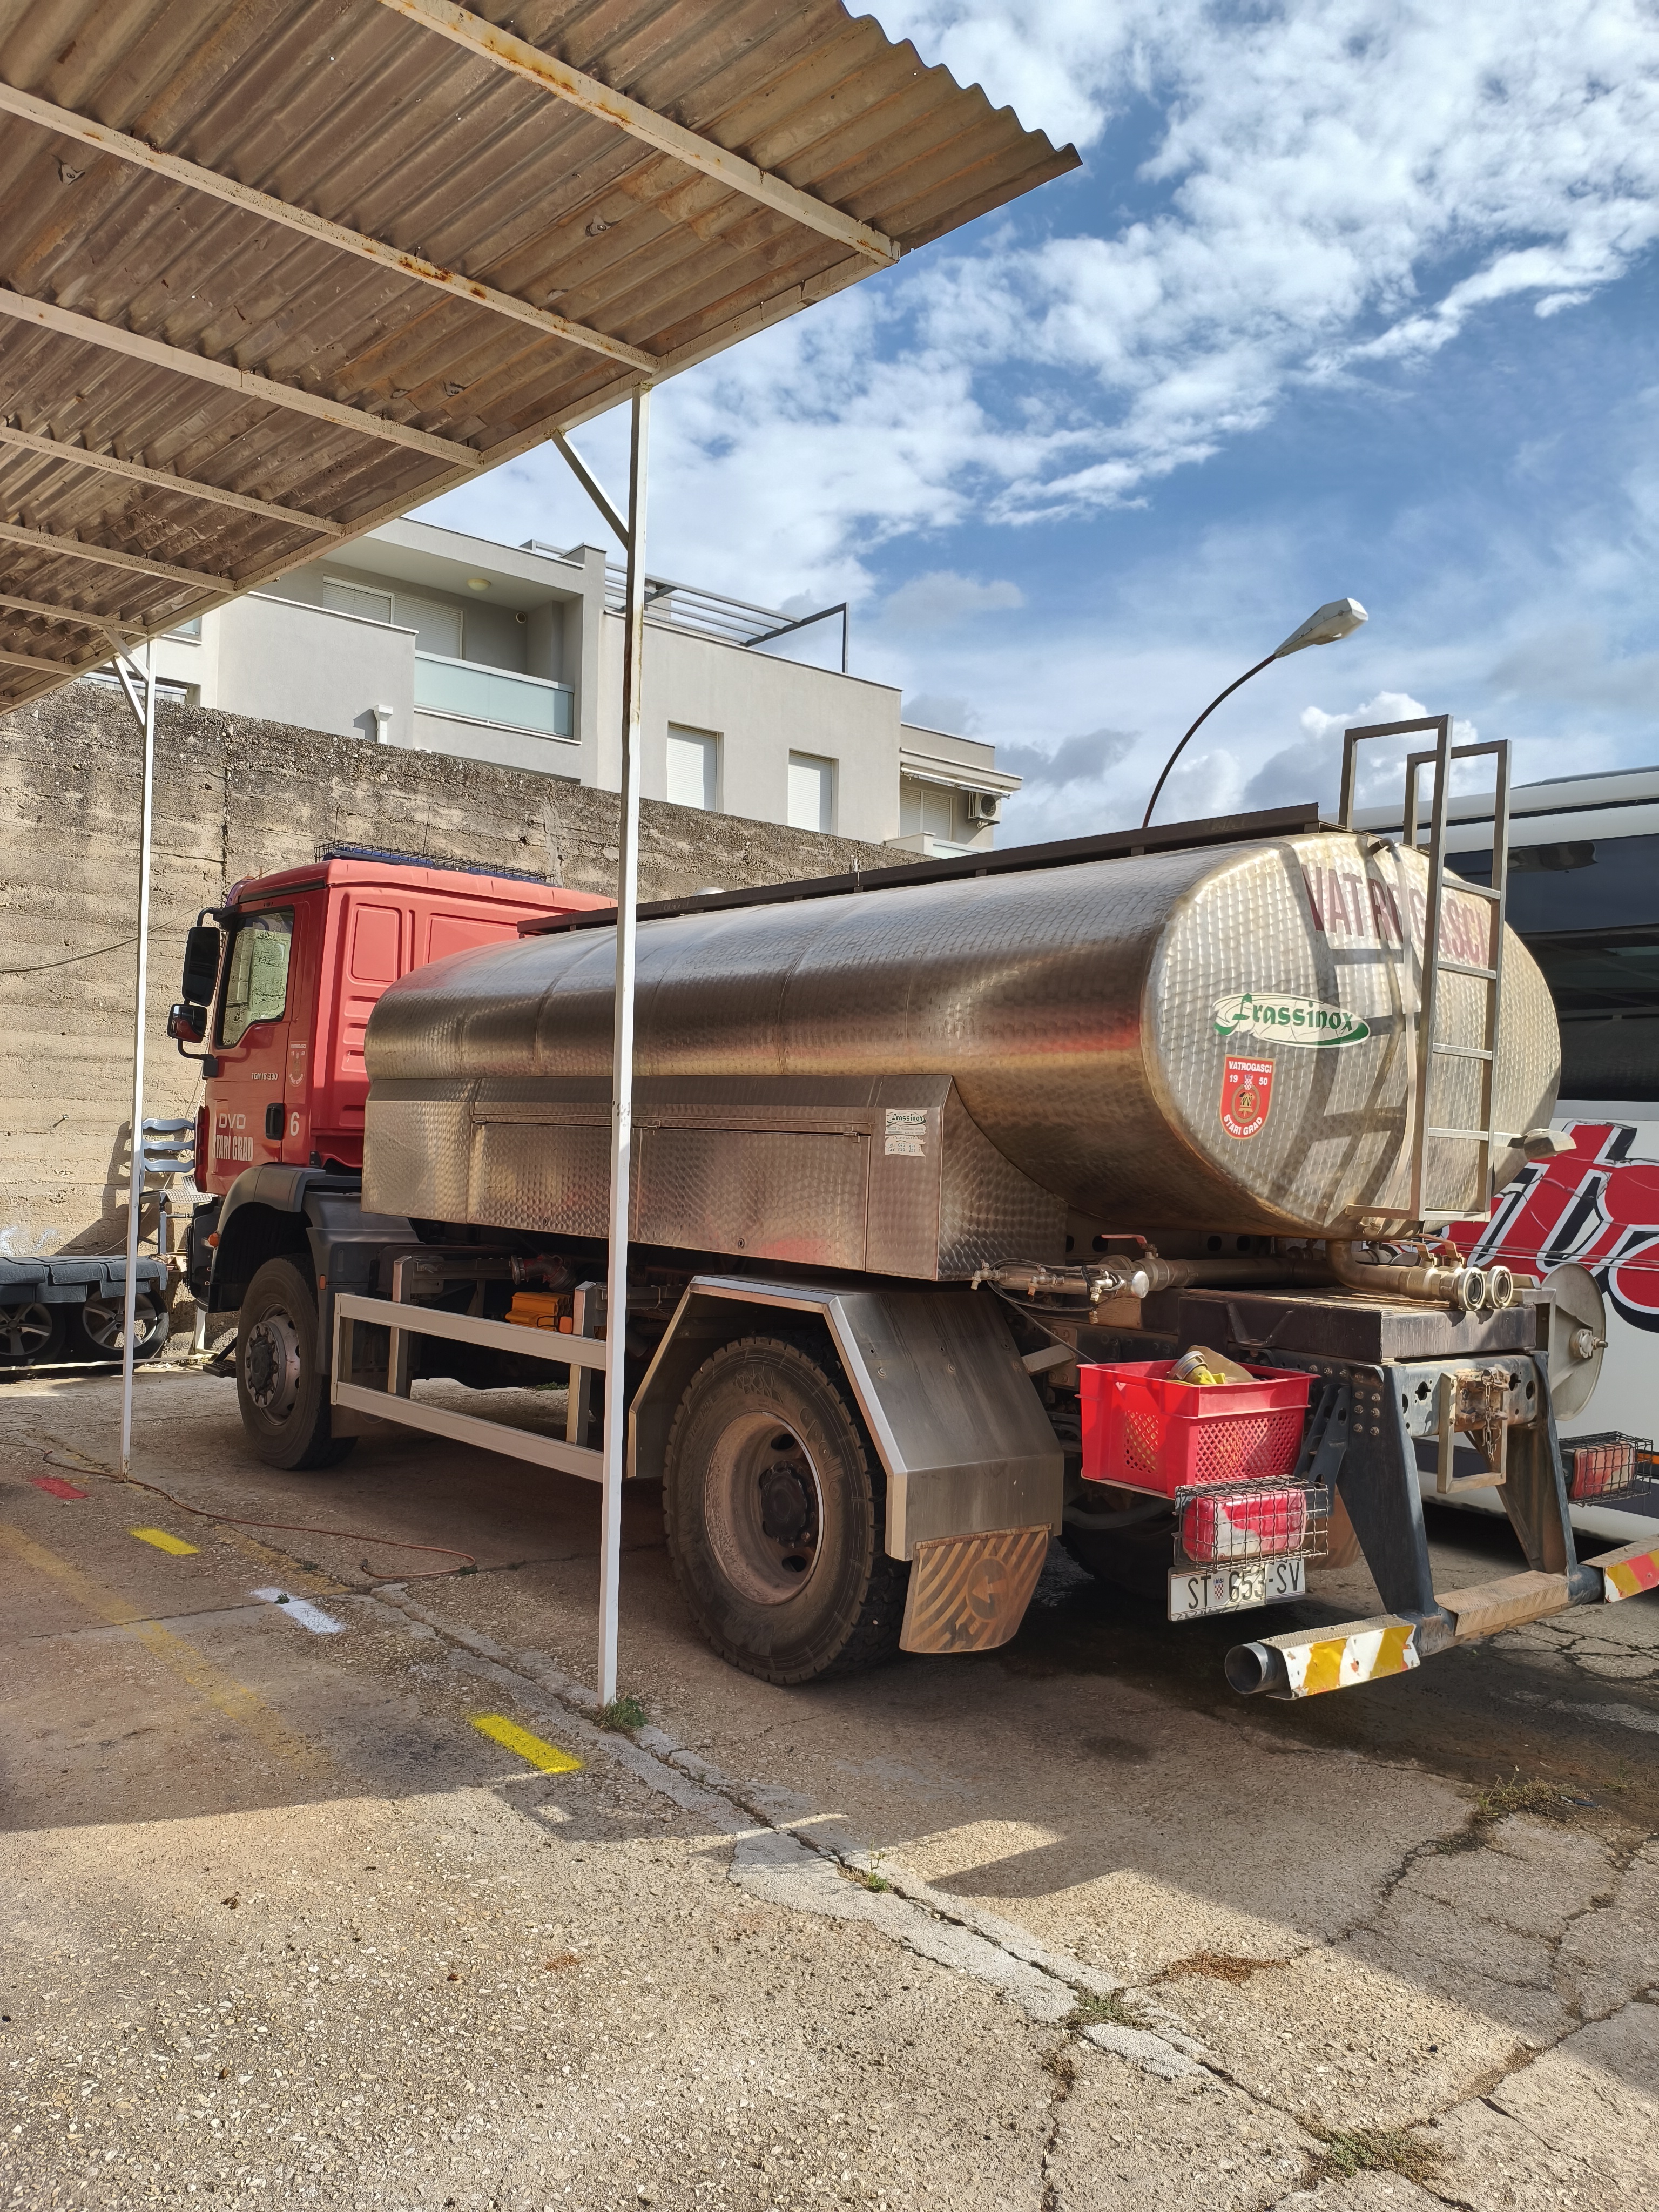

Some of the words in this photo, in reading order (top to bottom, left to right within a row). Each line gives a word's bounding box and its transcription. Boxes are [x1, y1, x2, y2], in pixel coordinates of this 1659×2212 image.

[1230, 993, 1353, 1033] Frassinox
[1228, 1061, 1272, 1073] VATROGASCI
[1229, 1074, 1238, 1083] 19
[1259, 1077, 1268, 1085] 50
[219, 1113, 246, 1129] DVD
[290, 1111, 300, 1136] 6
[1224, 1114, 1242, 1135] STARI
[1243, 1116, 1263, 1135] GRAD
[212, 1135, 231, 1159] STARI
[232, 1136, 253, 1162] GRAD
[1188, 1574, 1211, 1609] ST
